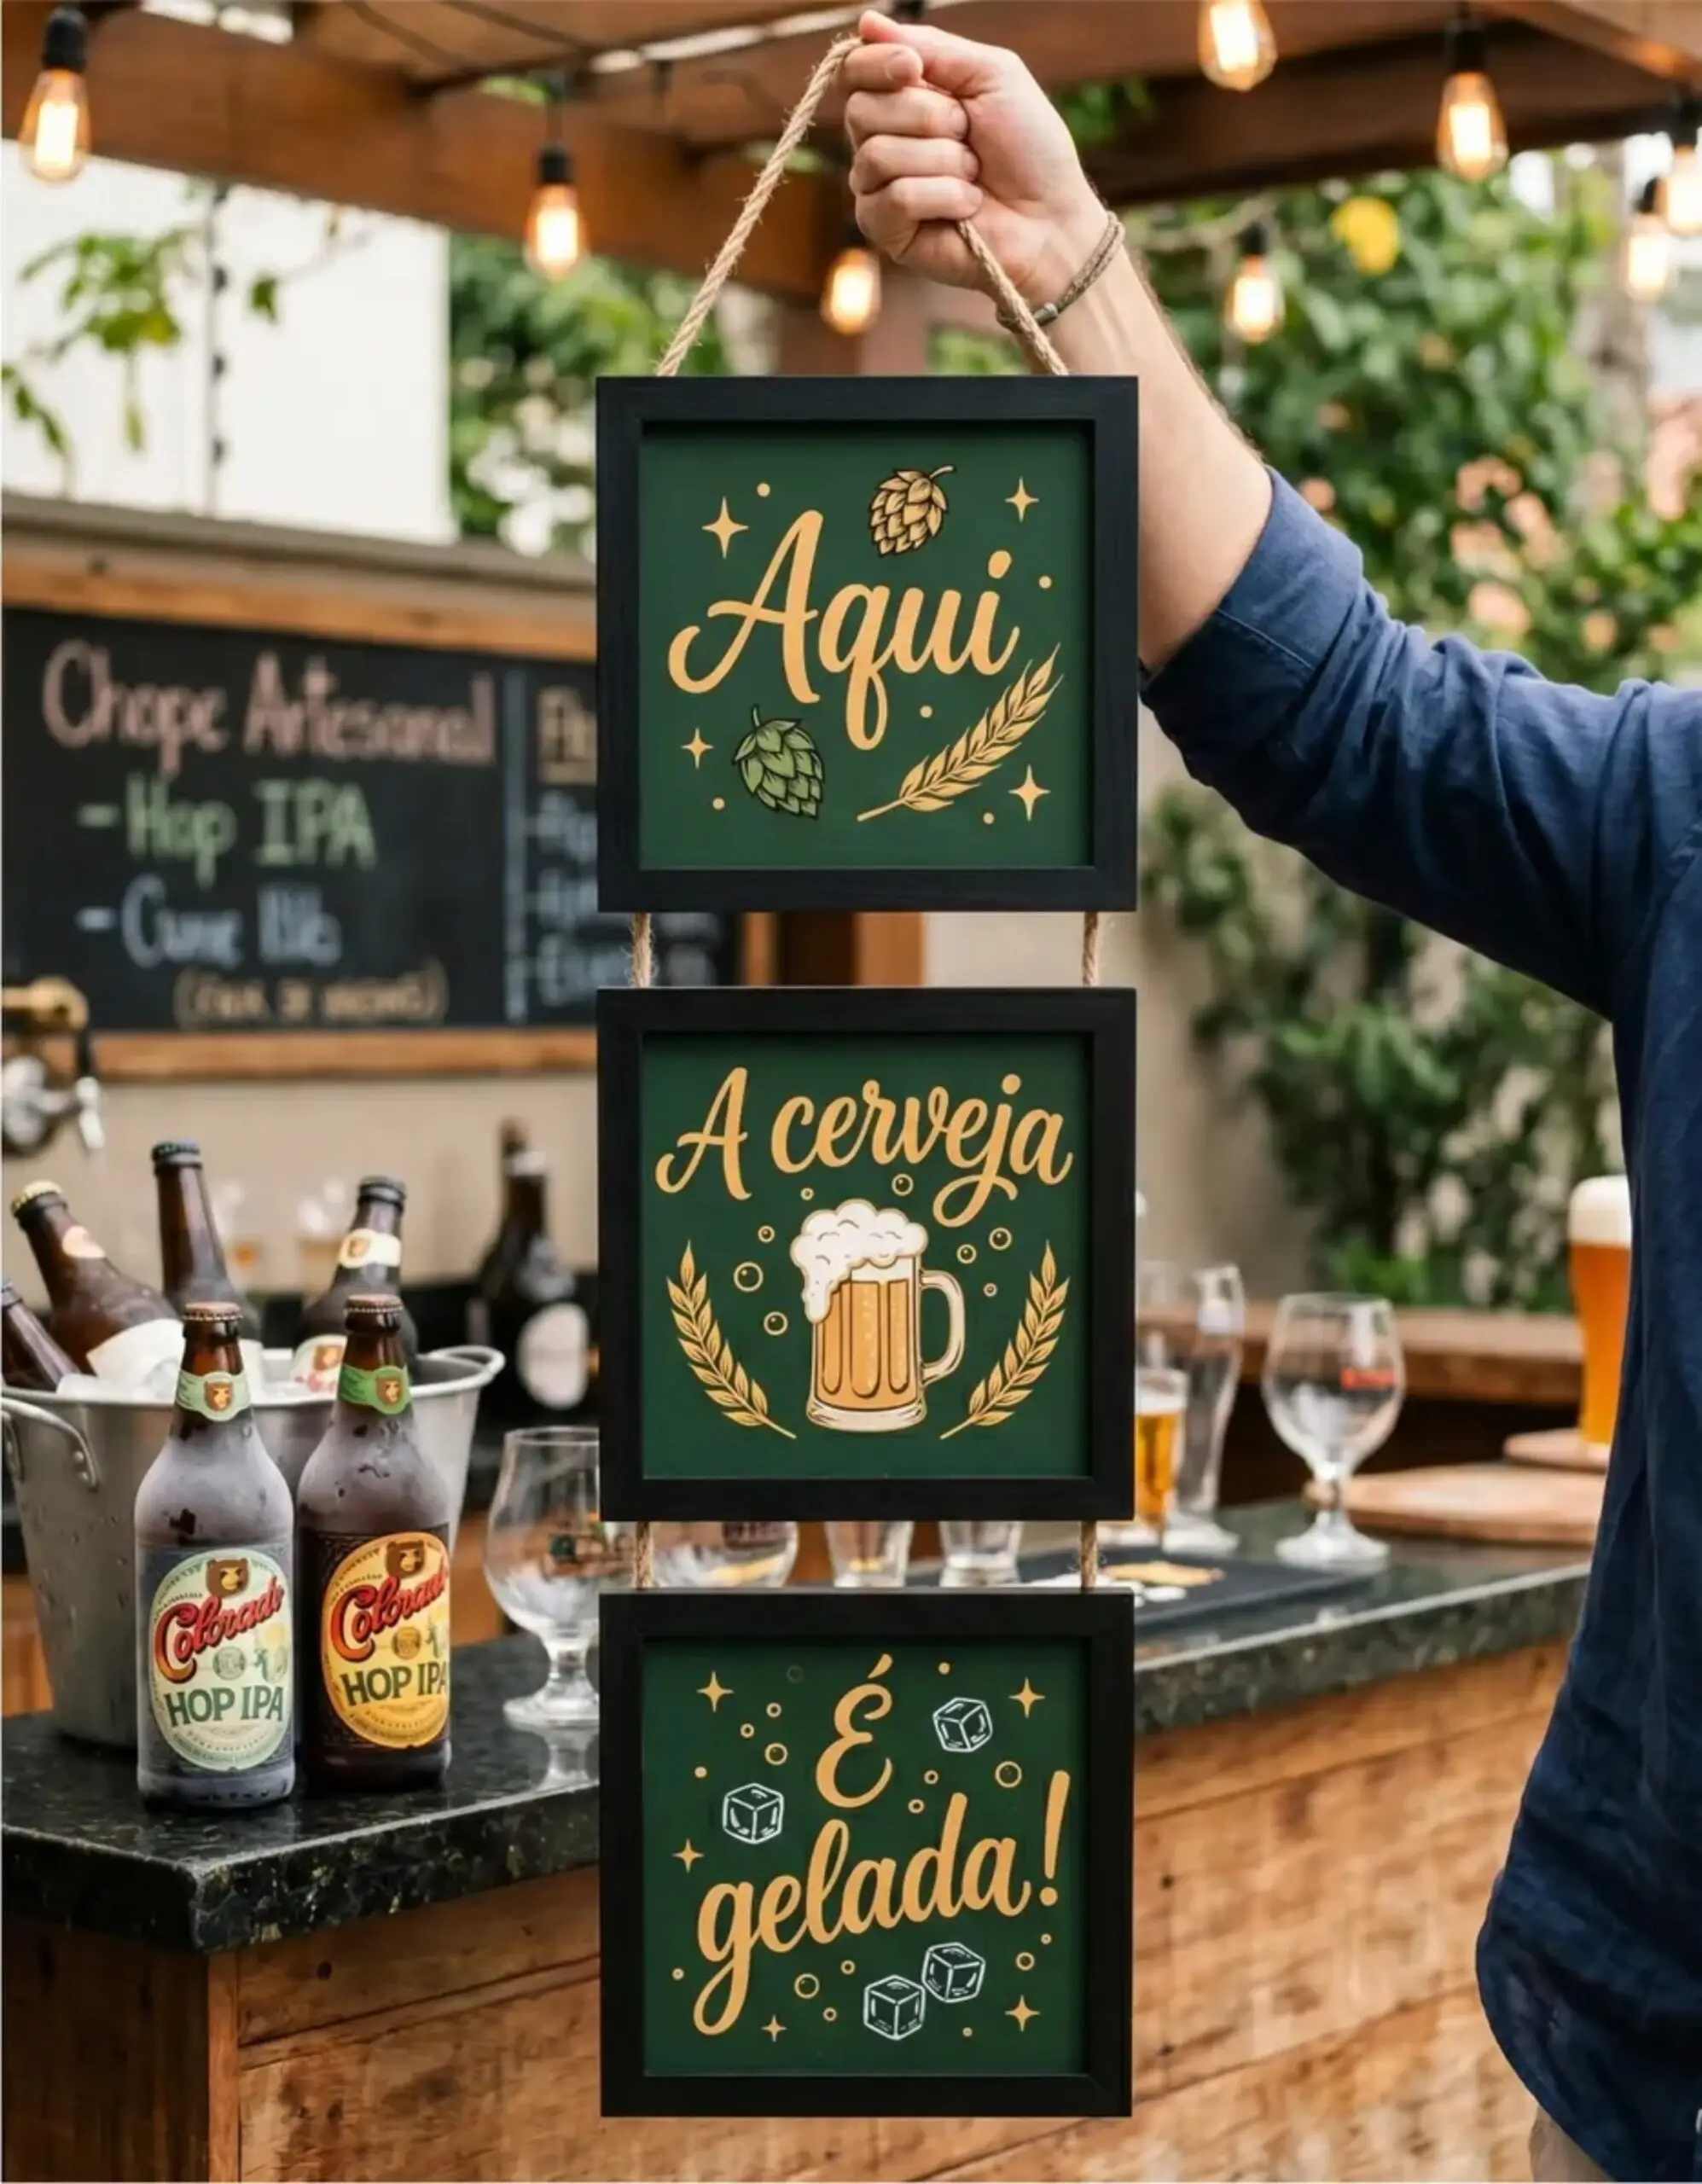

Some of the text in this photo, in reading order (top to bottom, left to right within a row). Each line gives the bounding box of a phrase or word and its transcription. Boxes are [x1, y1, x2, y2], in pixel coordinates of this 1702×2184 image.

[667, 509, 1020, 751] Aqui
[253, 776, 377, 870] IPA
[654, 1067, 1073, 1228] A cerveja
[164, 1687, 235, 1728] HOP
[241, 1685, 284, 1722] IPA
[340, 1666, 412, 1705] HOP
[816, 1653, 893, 1808] É
[693, 1769, 1071, 2036] gelada!
